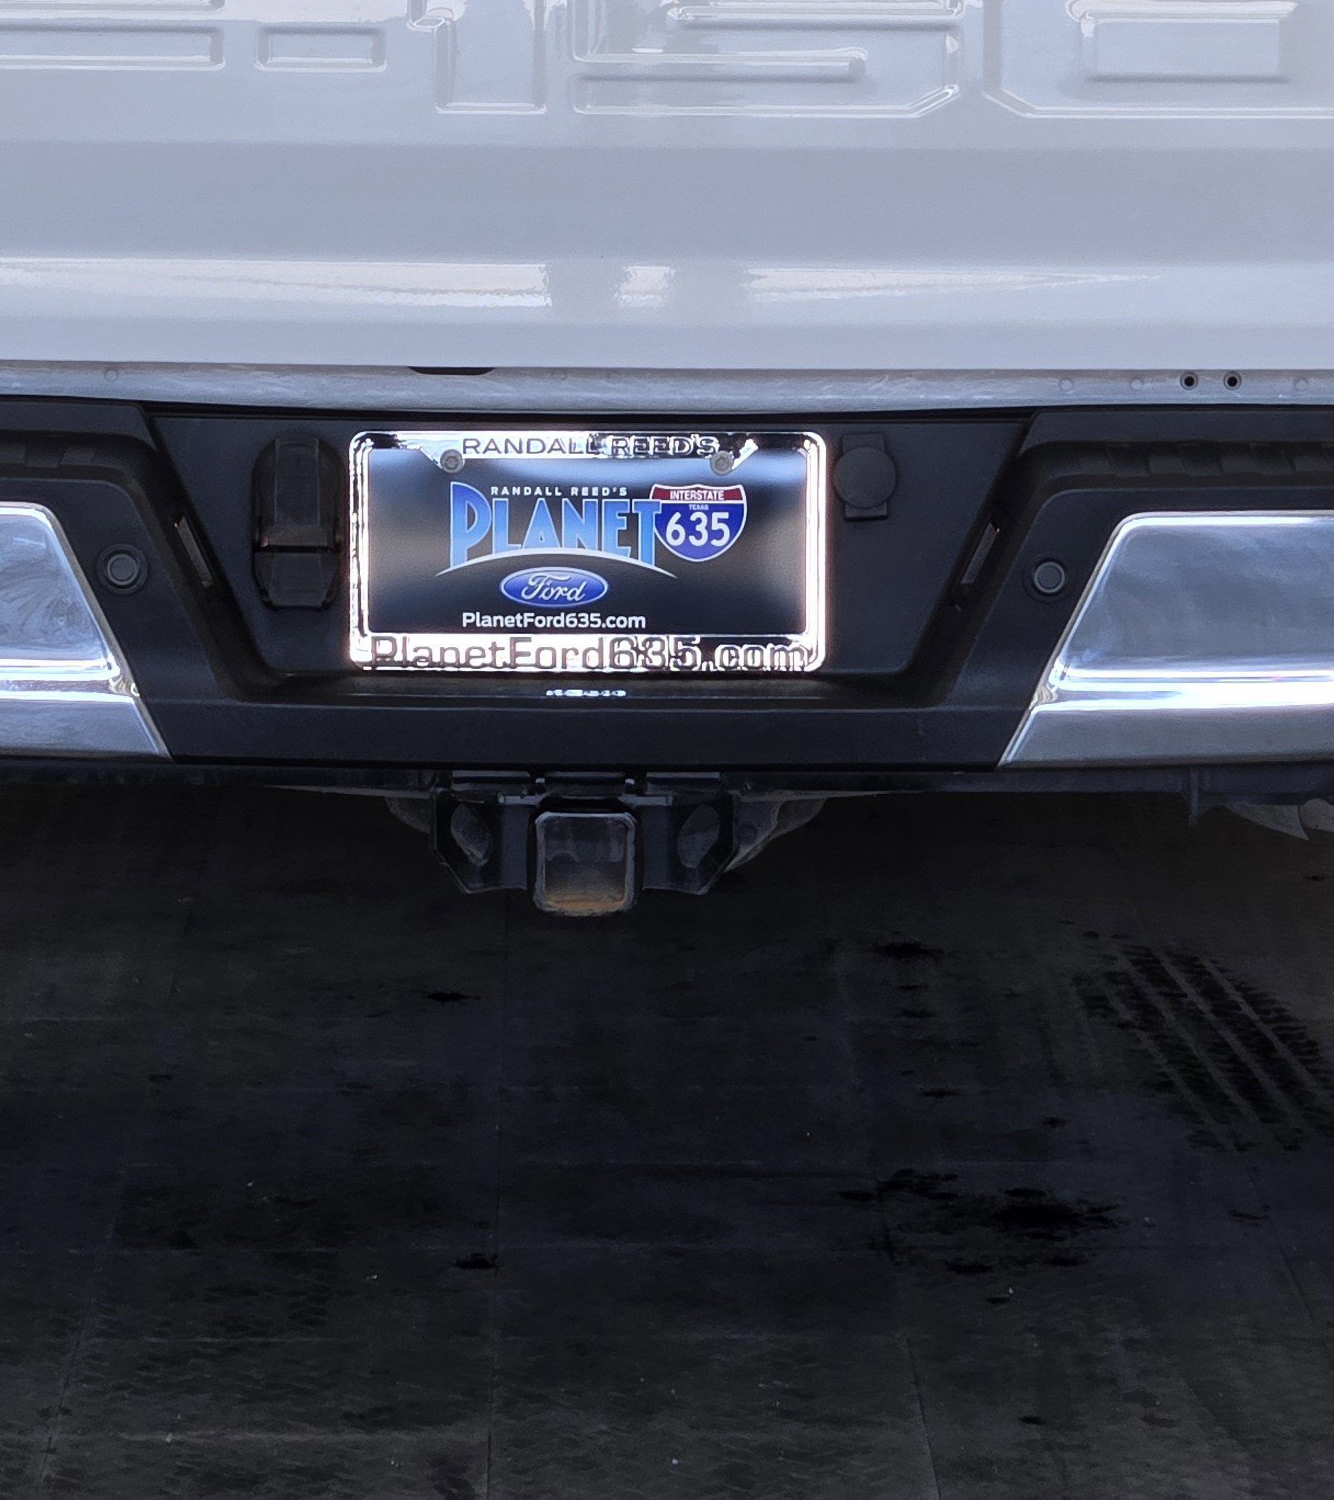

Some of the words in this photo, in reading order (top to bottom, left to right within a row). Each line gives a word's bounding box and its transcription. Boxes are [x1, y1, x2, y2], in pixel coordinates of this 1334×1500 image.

[463, 437, 599, 456] RANDALL
[611, 433, 720, 456] REED'S
[491, 486, 562, 496] RANDALL
[571, 486, 628, 496] REED'S
[670, 489, 725, 500] INTERSTATE
[450, 481, 662, 568] PLANET
[665, 511, 730, 547] 635
[521, 572, 587, 602] Ford
[462, 611, 646, 629] PlanetFord635.com
[370, 635, 808, 671] PlanetFord635.com
